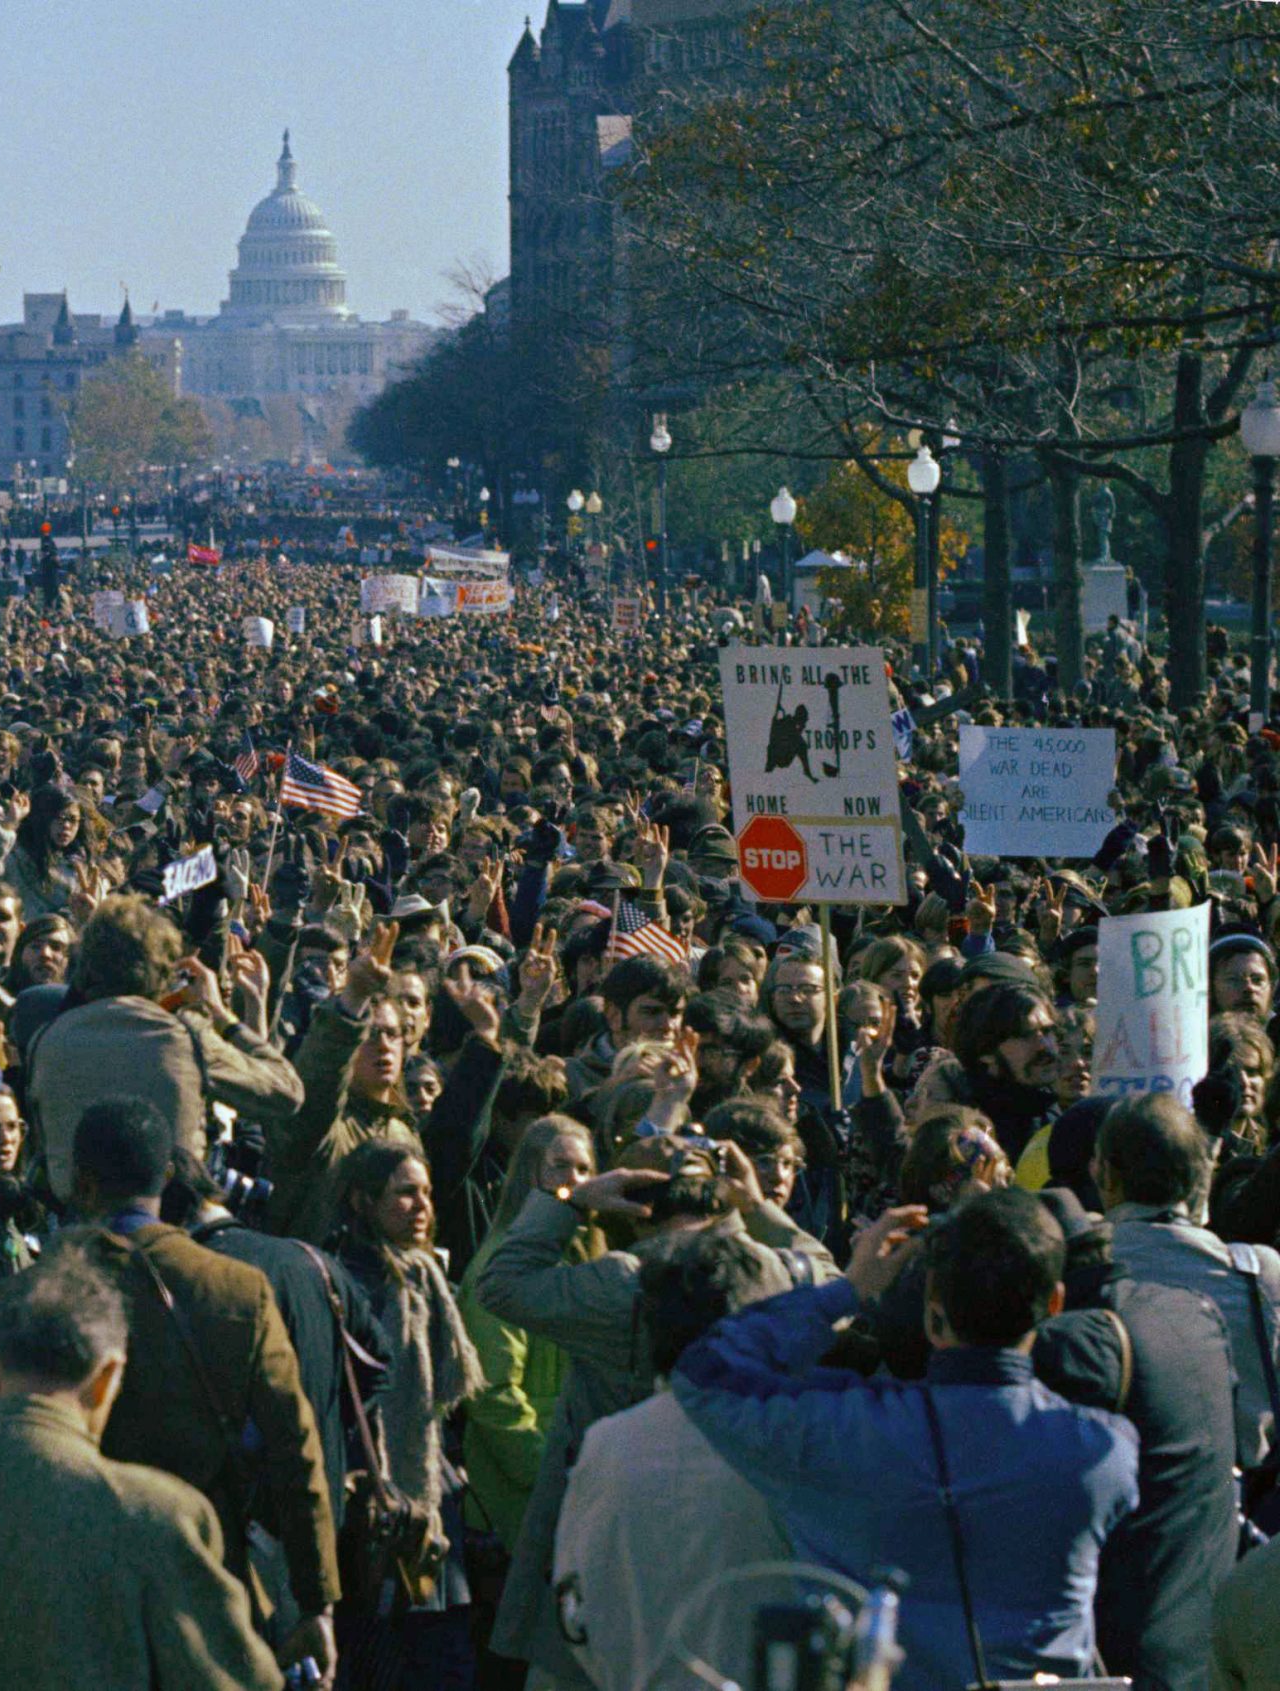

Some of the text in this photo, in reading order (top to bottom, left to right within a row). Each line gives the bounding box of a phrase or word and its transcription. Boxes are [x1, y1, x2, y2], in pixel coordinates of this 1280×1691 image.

[736, 664, 872, 685] BRING ALL THE
[805, 729, 877, 750] TROOPS
[987, 735, 1021, 751] THE
[988, 758, 1073, 779] WAR DEAD
[1021, 784, 1051, 800] ARE
[746, 794, 881, 817] HOME NOW
[1019, 803, 1114, 824] AMERICANS
[819, 831, 873, 858] THE
[744, 847, 801, 870] STOP
[815, 862, 888, 889] WAR
[1098, 1004, 1191, 1071] ALL
